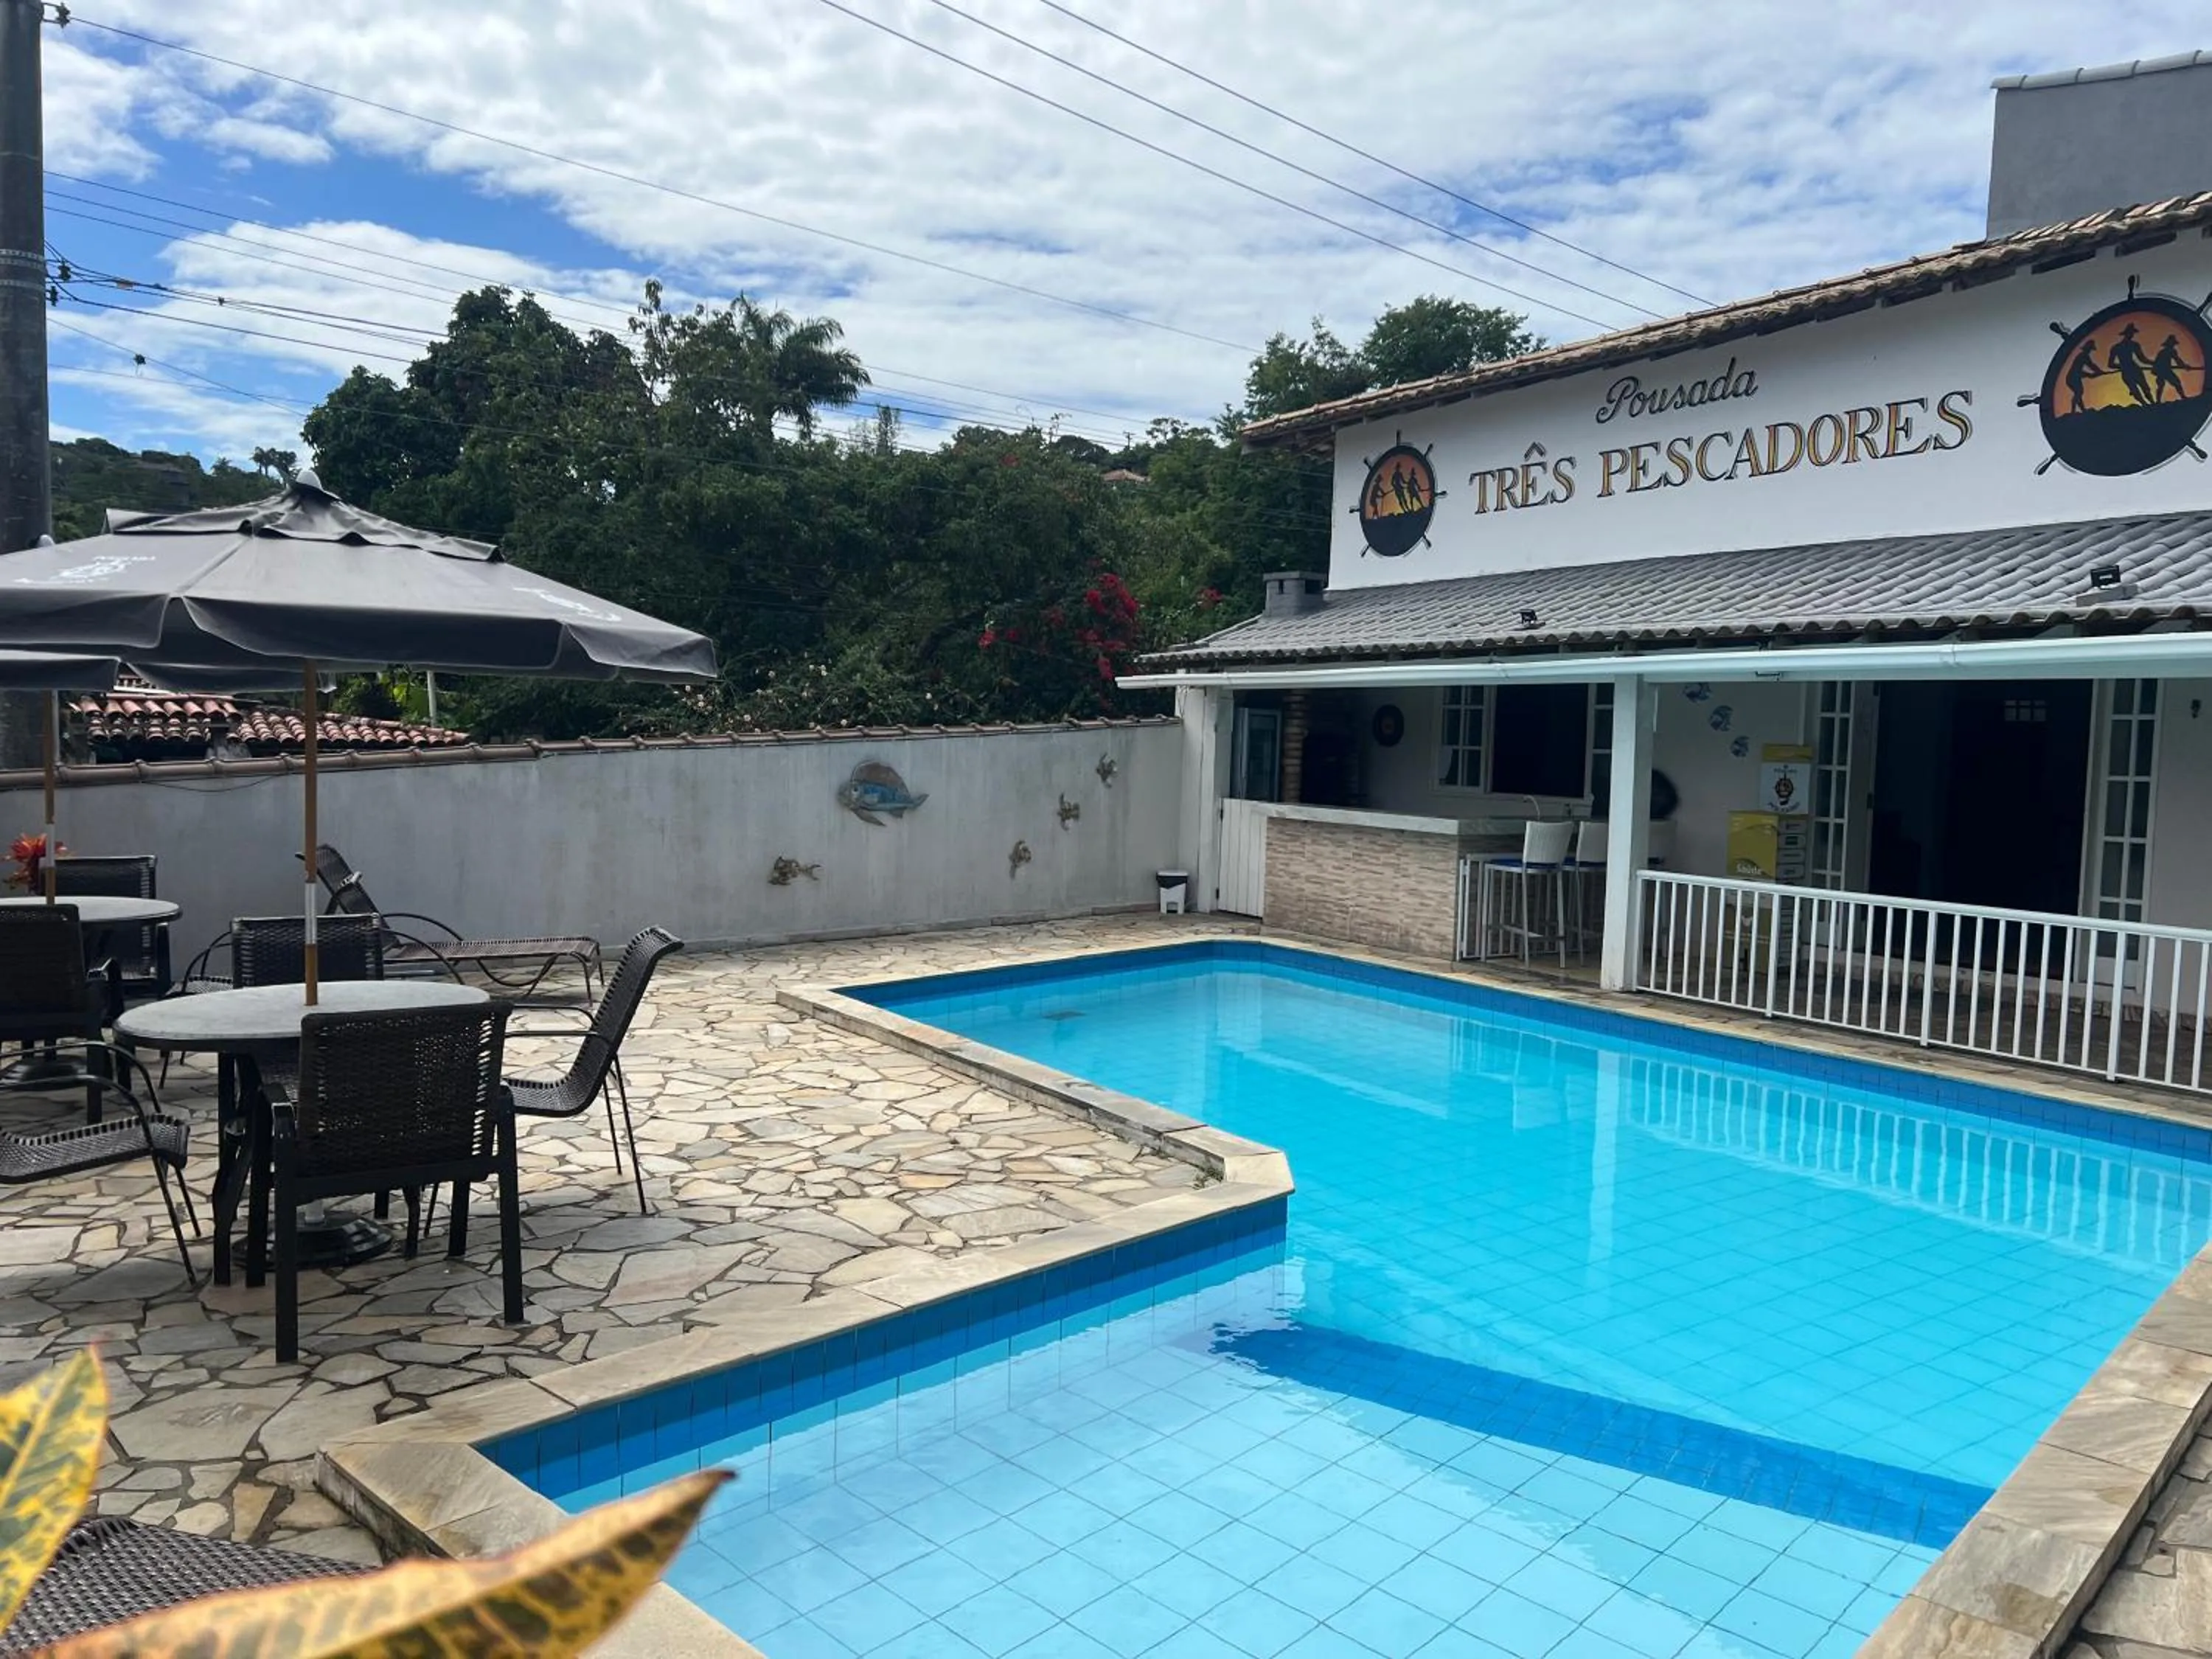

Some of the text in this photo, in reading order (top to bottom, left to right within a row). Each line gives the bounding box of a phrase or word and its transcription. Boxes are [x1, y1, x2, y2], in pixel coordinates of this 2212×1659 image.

[1596, 357, 1759, 423] Pousada
[1469, 390, 1973, 515] TRÊS PESCADORES
